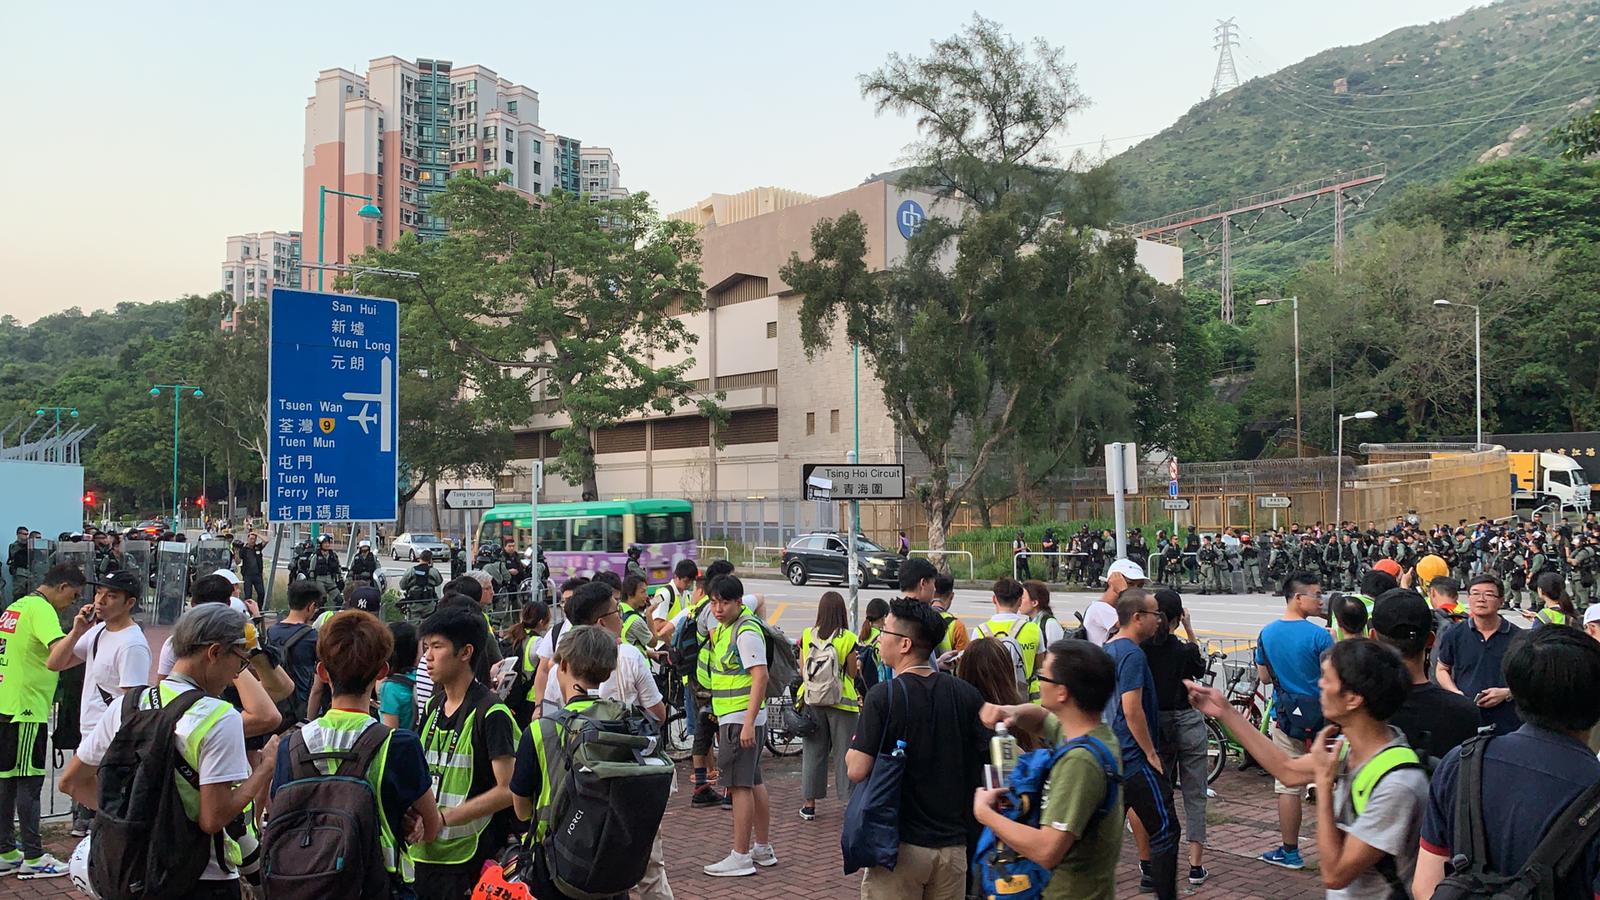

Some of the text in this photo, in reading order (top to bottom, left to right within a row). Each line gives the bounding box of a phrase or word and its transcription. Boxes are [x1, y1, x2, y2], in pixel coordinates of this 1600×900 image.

[332, 301, 377, 316] San Hui
[331, 319, 365, 336] 新墟
[332, 337, 391, 354] Yuen Long
[330, 355, 364, 371] 元朗
[279, 399, 343, 413] Tsuen Wan
[278, 418, 331, 434] 荃灣 9
[279, 435, 335, 448] Tuen Mun
[278, 454, 313, 470] 屯門
[278, 472, 336, 484] Tuen Mun
[825, 468, 900, 479] Tsing Hoi Circuit
[278, 487, 339, 500] Ferry Pier
[843, 483, 883, 495] 青海圍
[278, 504, 350, 520] 屯門碼頭
